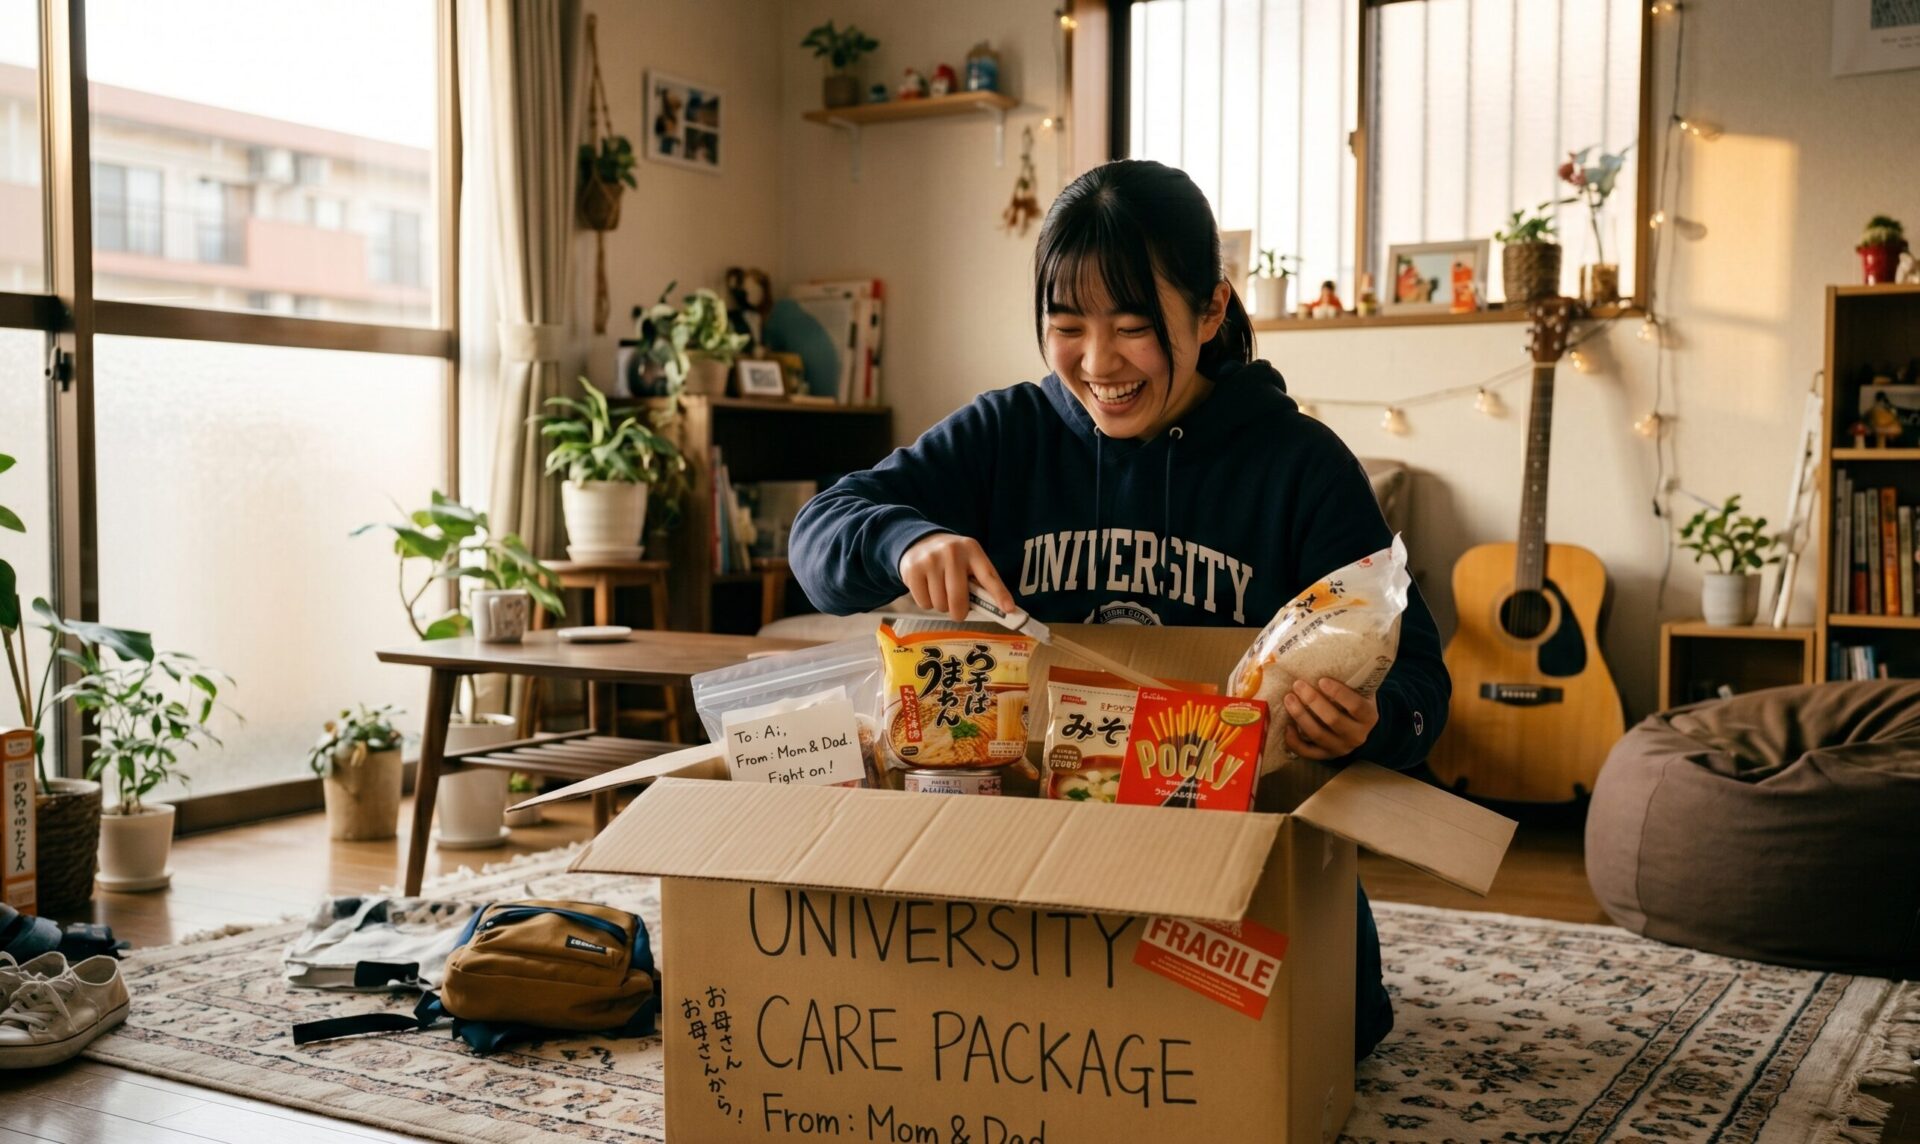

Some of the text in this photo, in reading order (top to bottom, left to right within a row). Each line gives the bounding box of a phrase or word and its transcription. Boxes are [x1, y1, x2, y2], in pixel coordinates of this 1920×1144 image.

[1019, 528, 1253, 624] UNIVERSITY
[777, 745, 807, 759] Mom
[809, 740, 819, 752] &
[1062, 713, 1131, 745] みそ
[768, 767, 805, 785] Fight
[749, 887, 1136, 989] UNIVERSITY
[1148, 917, 1275, 990] FRAGILE
[705, 986, 743, 1070] お母さん
[757, 995, 1198, 1108] CARE PACKAGE
[763, 1093, 854, 1135] From:
[868, 1104, 939, 1143] Mom
[951, 1115, 971, 1144] &
